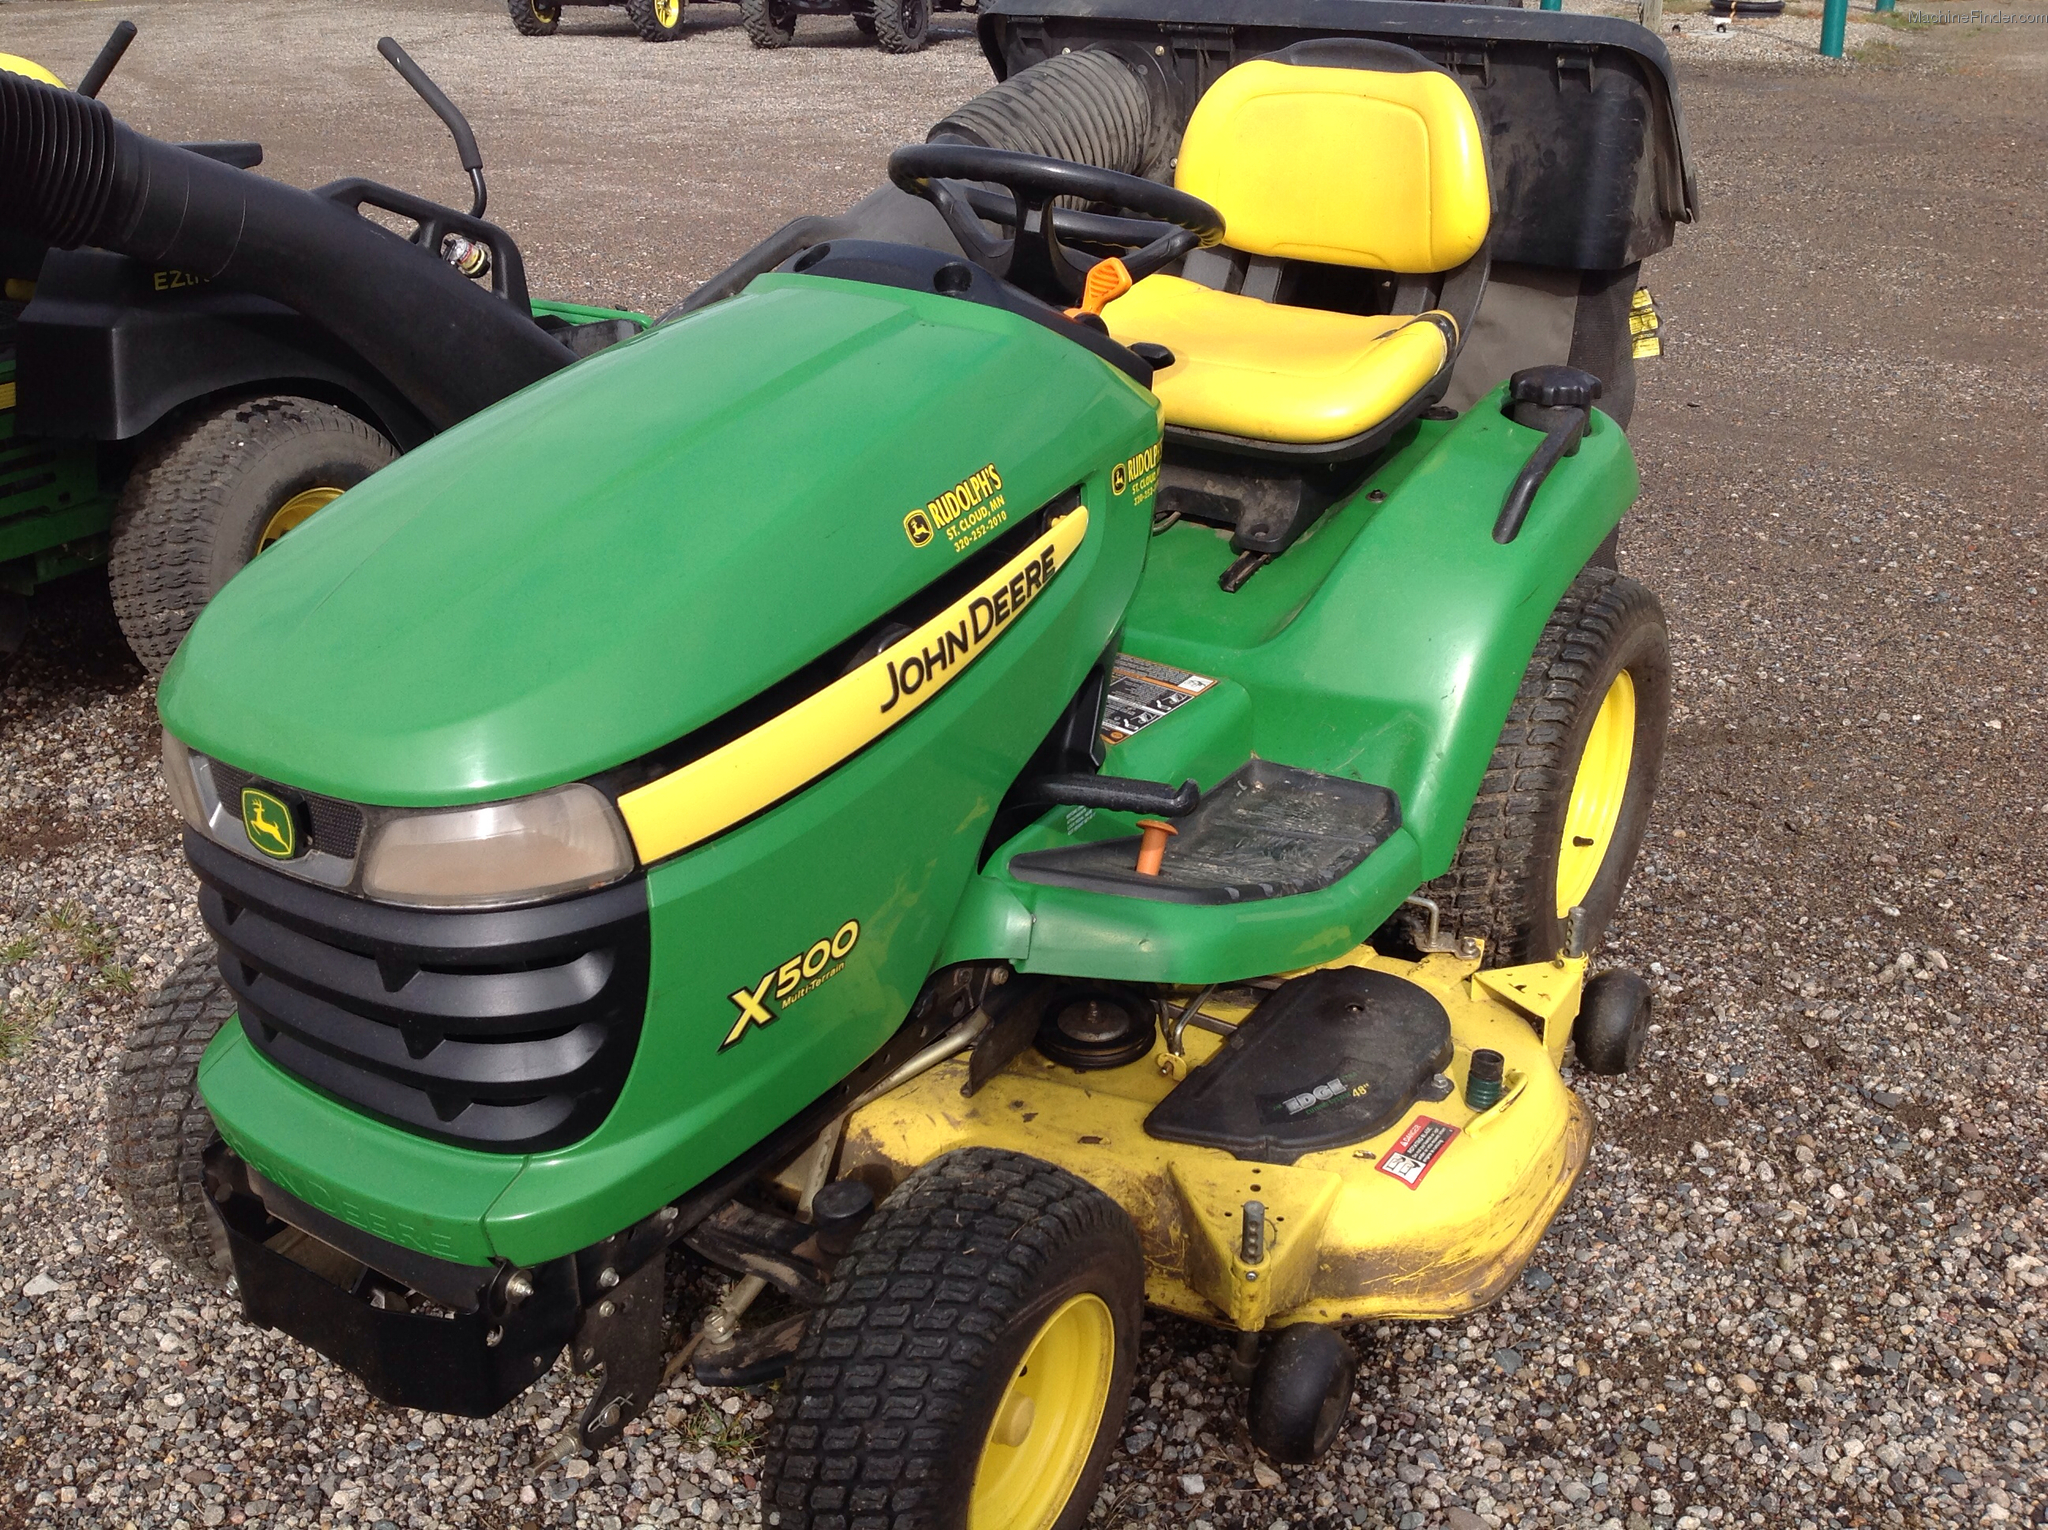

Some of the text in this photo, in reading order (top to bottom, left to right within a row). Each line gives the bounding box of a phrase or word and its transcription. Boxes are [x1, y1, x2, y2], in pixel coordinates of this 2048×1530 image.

[1127, 443, 1162, 483] RUDOLP
[926, 463, 1003, 531] RUDOLPH'S
[946, 494, 1006, 540] ST. CLOUD, MN
[954, 510, 1007, 552] 320-252-2010
[880, 544, 1057, 713] JOHN DEERE
[719, 919, 860, 1052] X500
[781, 961, 846, 1009] Multi-Terrain
[1282, 1078, 1347, 1115] EDGE
[304, 1178, 459, 1260] DEERE
